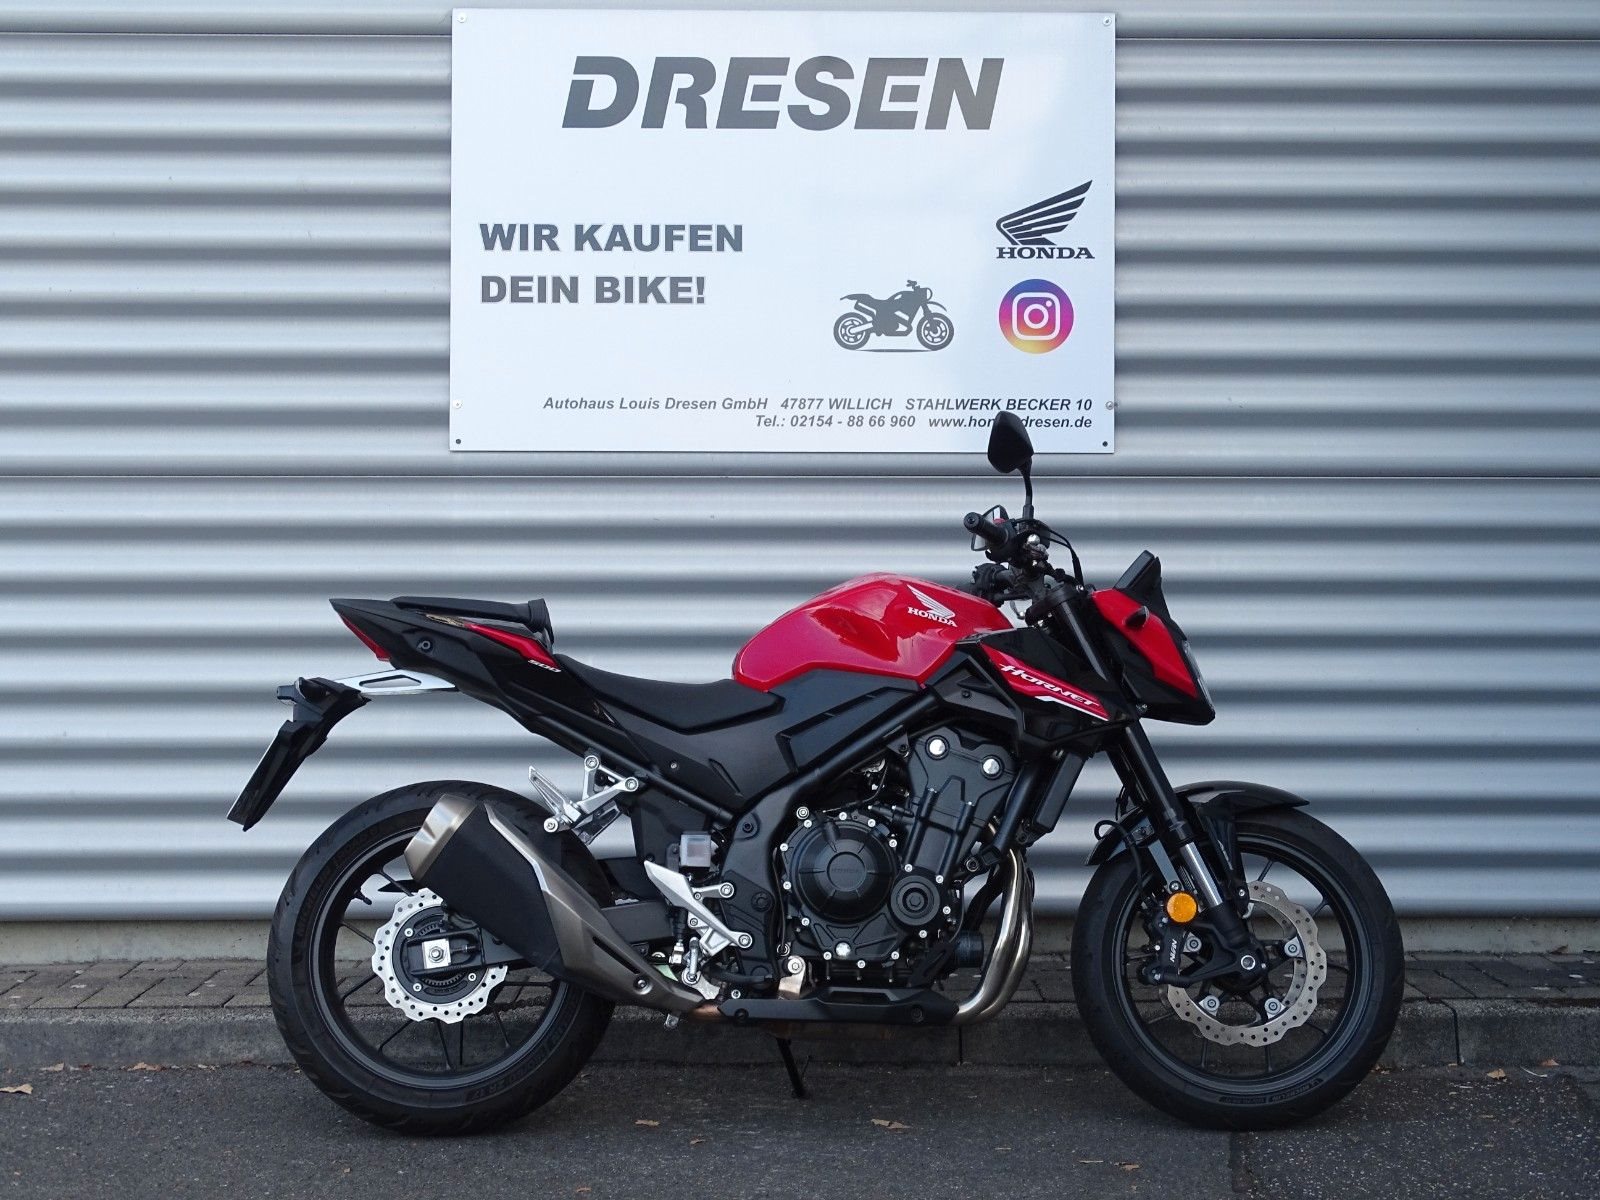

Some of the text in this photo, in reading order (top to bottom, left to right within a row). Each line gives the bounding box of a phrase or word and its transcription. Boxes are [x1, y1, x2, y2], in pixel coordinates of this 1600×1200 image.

[562, 56, 1004, 131] DRESEN
[479, 224, 744, 252] WIR KAUFEN
[996, 247, 1095, 260] HONDA
[481, 275, 706, 304] DEIN BIKE!
[543, 397, 1092, 411] Autohaus Louis Dresen GmbH 47877 WILLICH STAHLWERK BECKER 10
[756, 415, 785, 427] Tel.:
[790, 415, 833, 427] 02154
[847, 415, 864, 428] 88
[869, 415, 885, 428] 66
[890, 415, 915, 428] 960
[928, 414, 1092, 429] www.hondresen.de
[907, 606, 958, 628] HONDA
